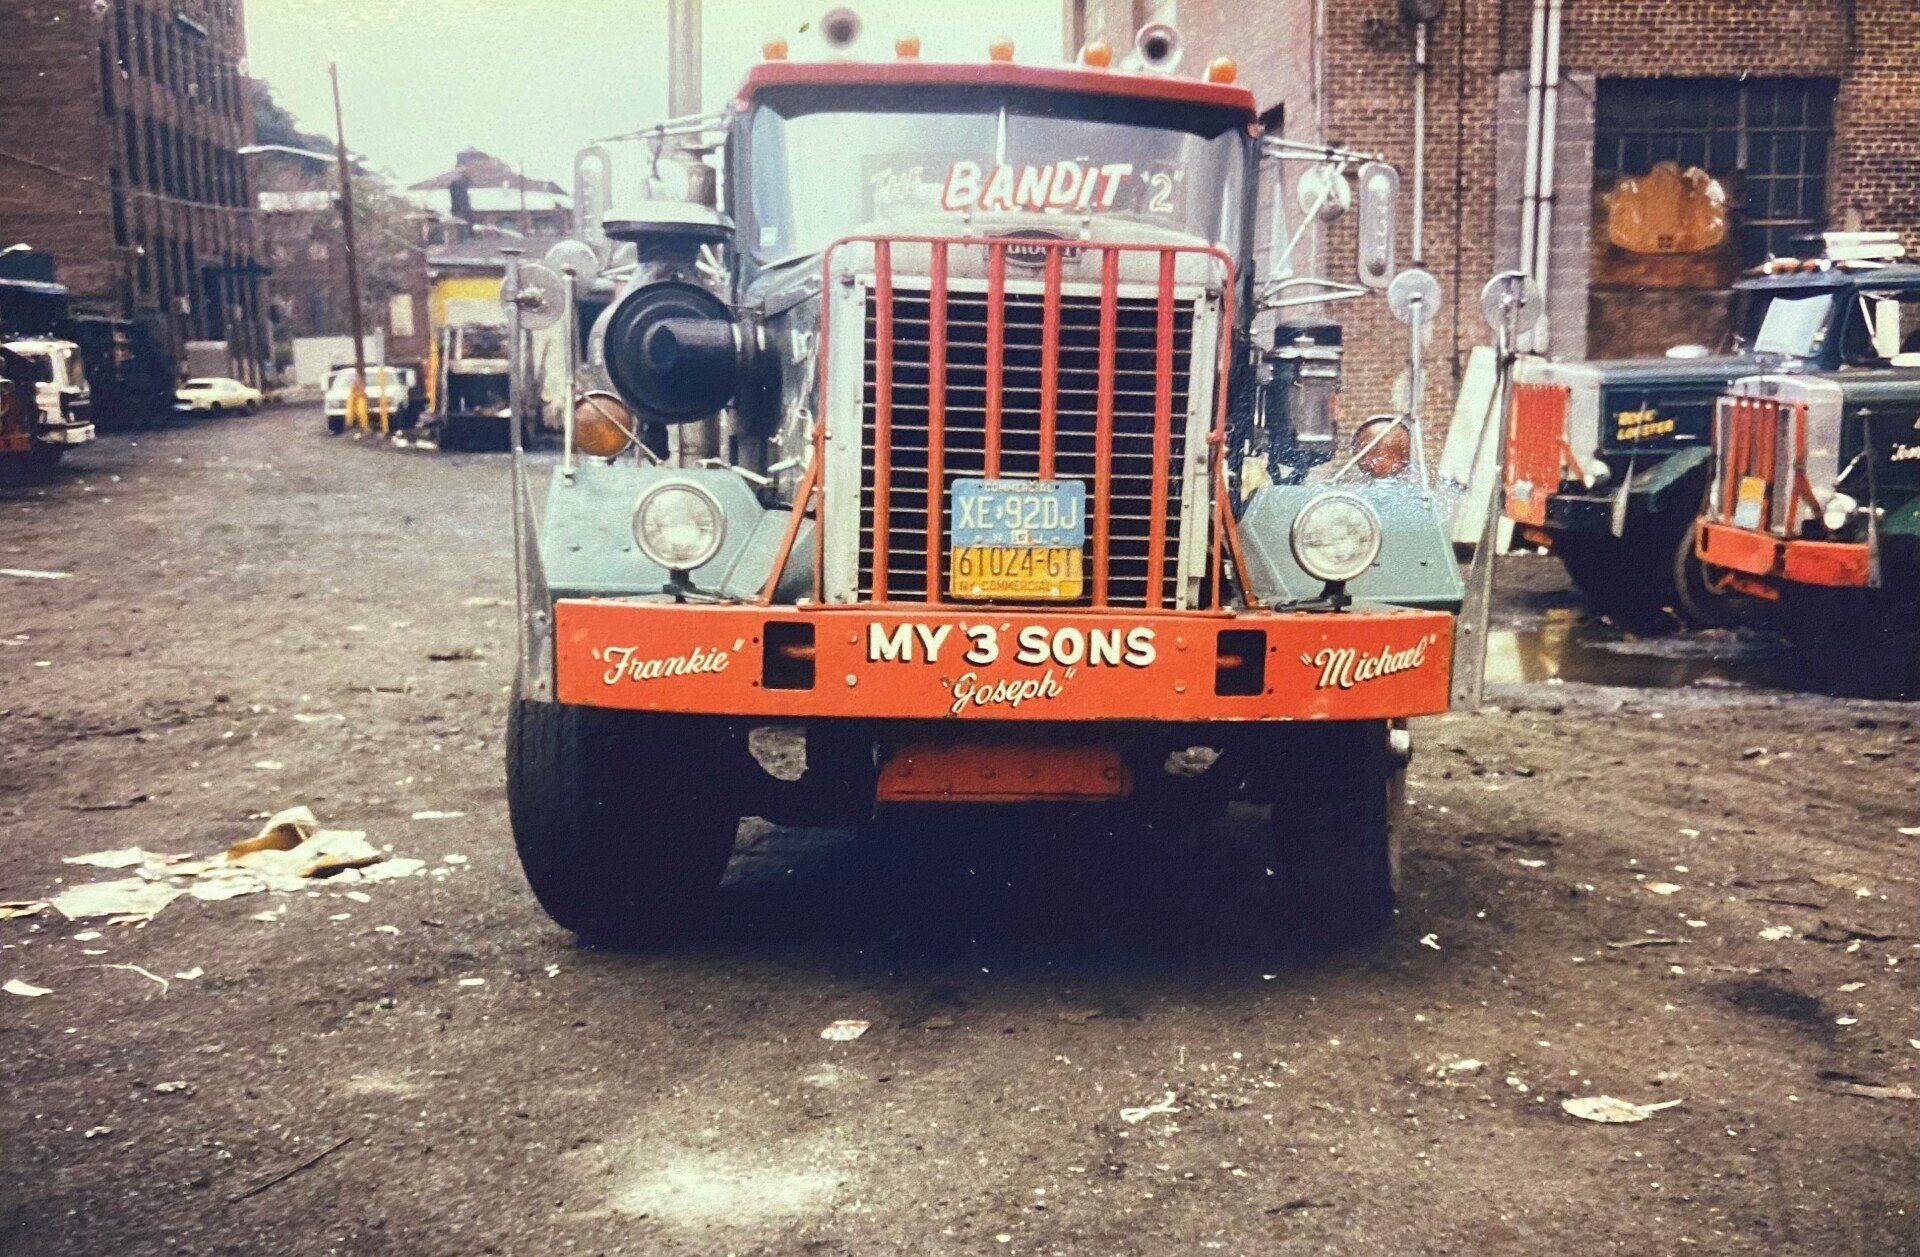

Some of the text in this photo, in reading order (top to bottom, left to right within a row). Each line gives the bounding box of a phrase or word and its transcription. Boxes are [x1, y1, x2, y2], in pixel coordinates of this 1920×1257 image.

[942, 159, 1133, 212] BANDIT
[866, 622, 953, 663] MY
[1013, 625, 1157, 668] SONS
